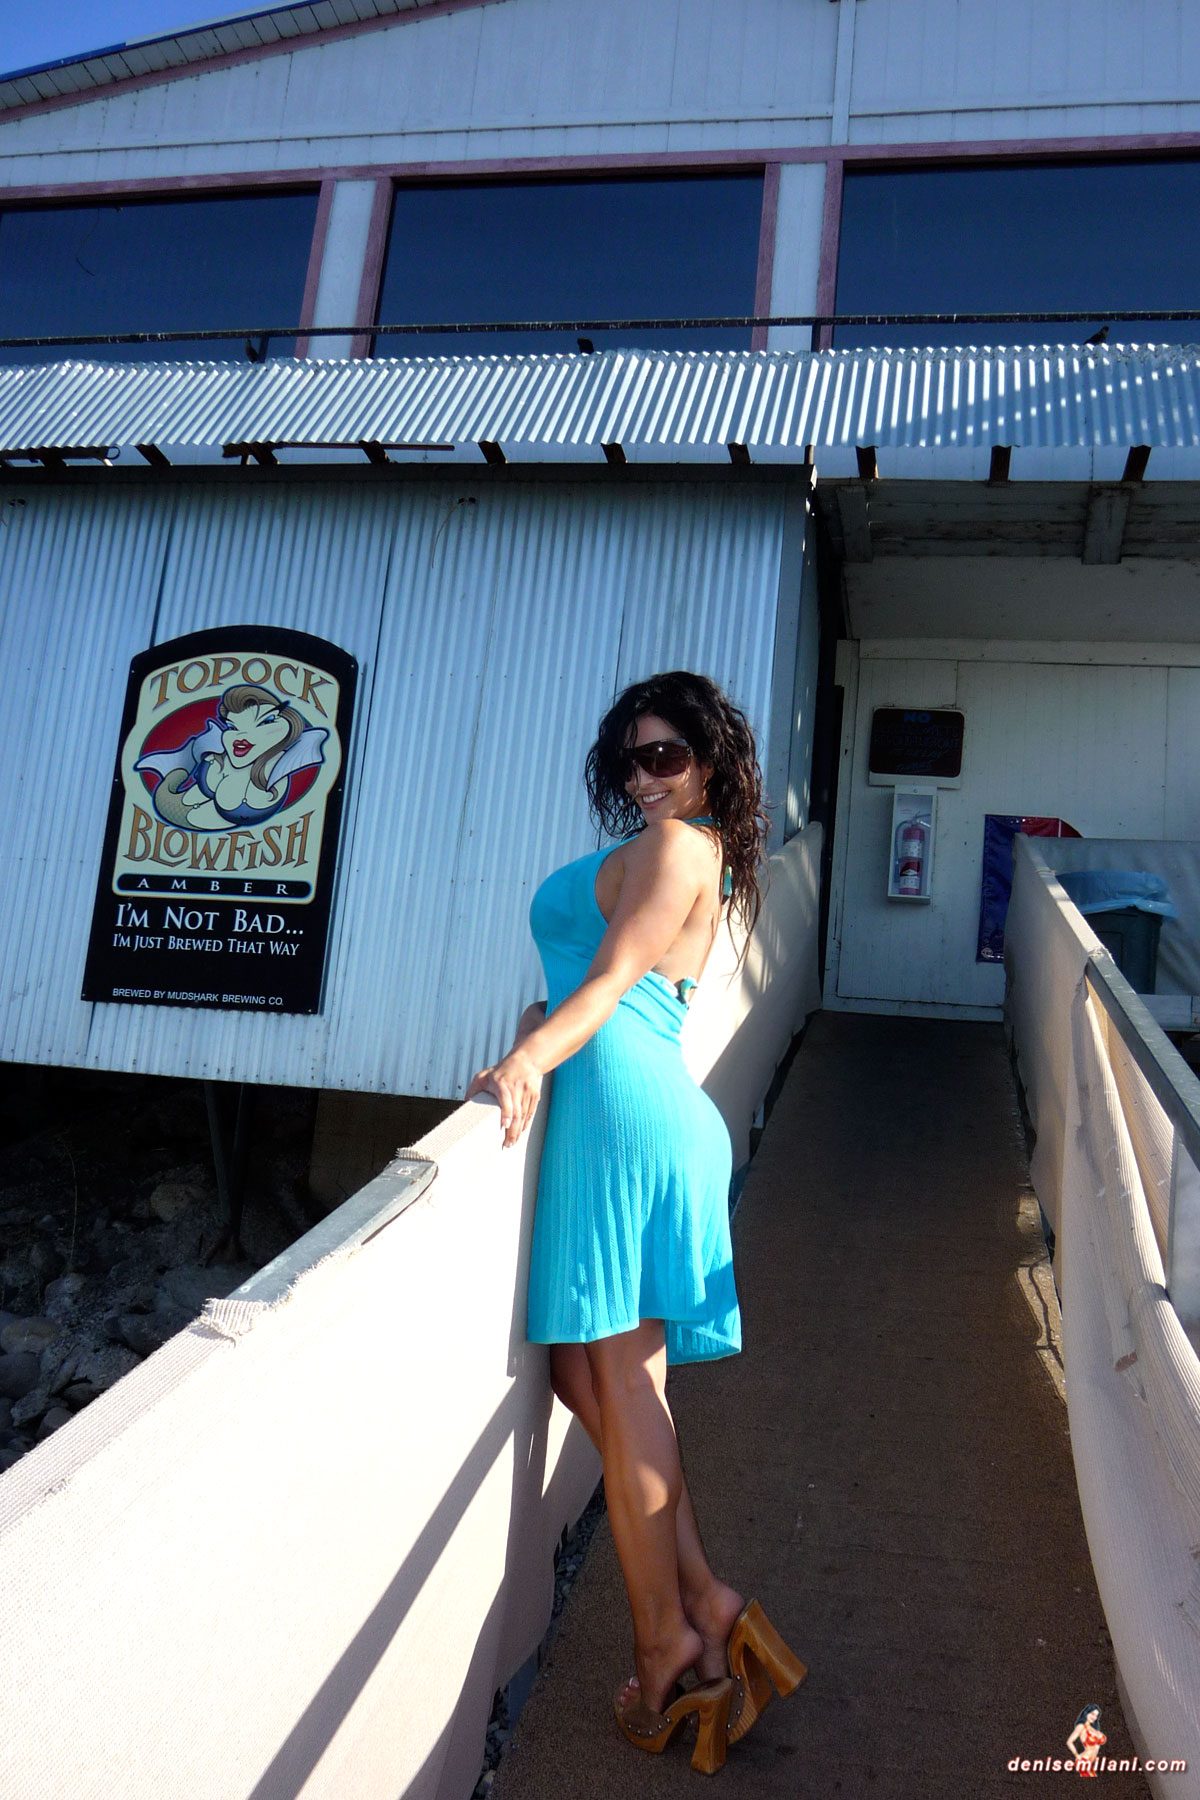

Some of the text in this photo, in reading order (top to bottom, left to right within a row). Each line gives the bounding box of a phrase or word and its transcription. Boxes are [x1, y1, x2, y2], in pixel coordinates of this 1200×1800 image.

[151, 657, 334, 718] TOPOCK
[903, 711, 932, 724] NO
[123, 803, 316, 872] BLOWFISH
[137, 877, 289, 895] AMBER
[115, 903, 304, 935] I'M NOT BAD...
[113, 932, 300, 956] I'M JUST BREWED THAT WAY
[112, 988, 152, 998] BREWED
[153, 990, 166, 999] BY
[167, 991, 219, 1002] MUDSHARK
[222, 994, 266, 1005] BREWING
